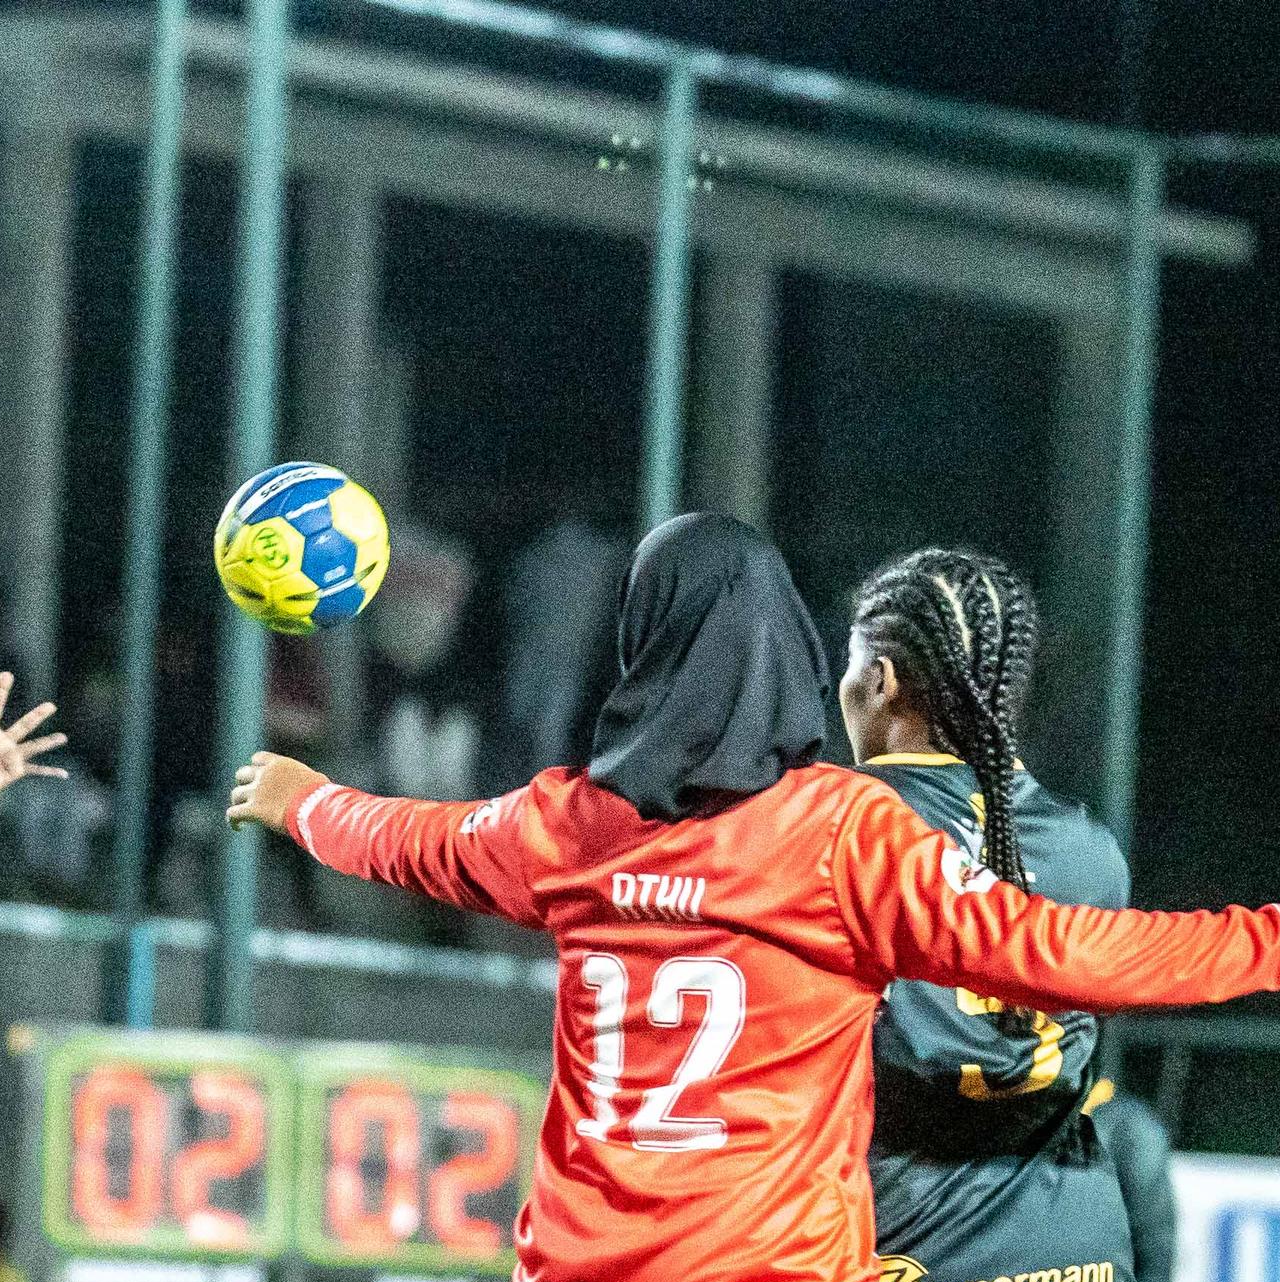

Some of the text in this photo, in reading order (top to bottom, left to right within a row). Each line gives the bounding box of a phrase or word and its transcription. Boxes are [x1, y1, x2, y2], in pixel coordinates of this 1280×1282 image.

[576, 951, 746, 1153] 12
[74, 1068, 521, 1257] 02 02
